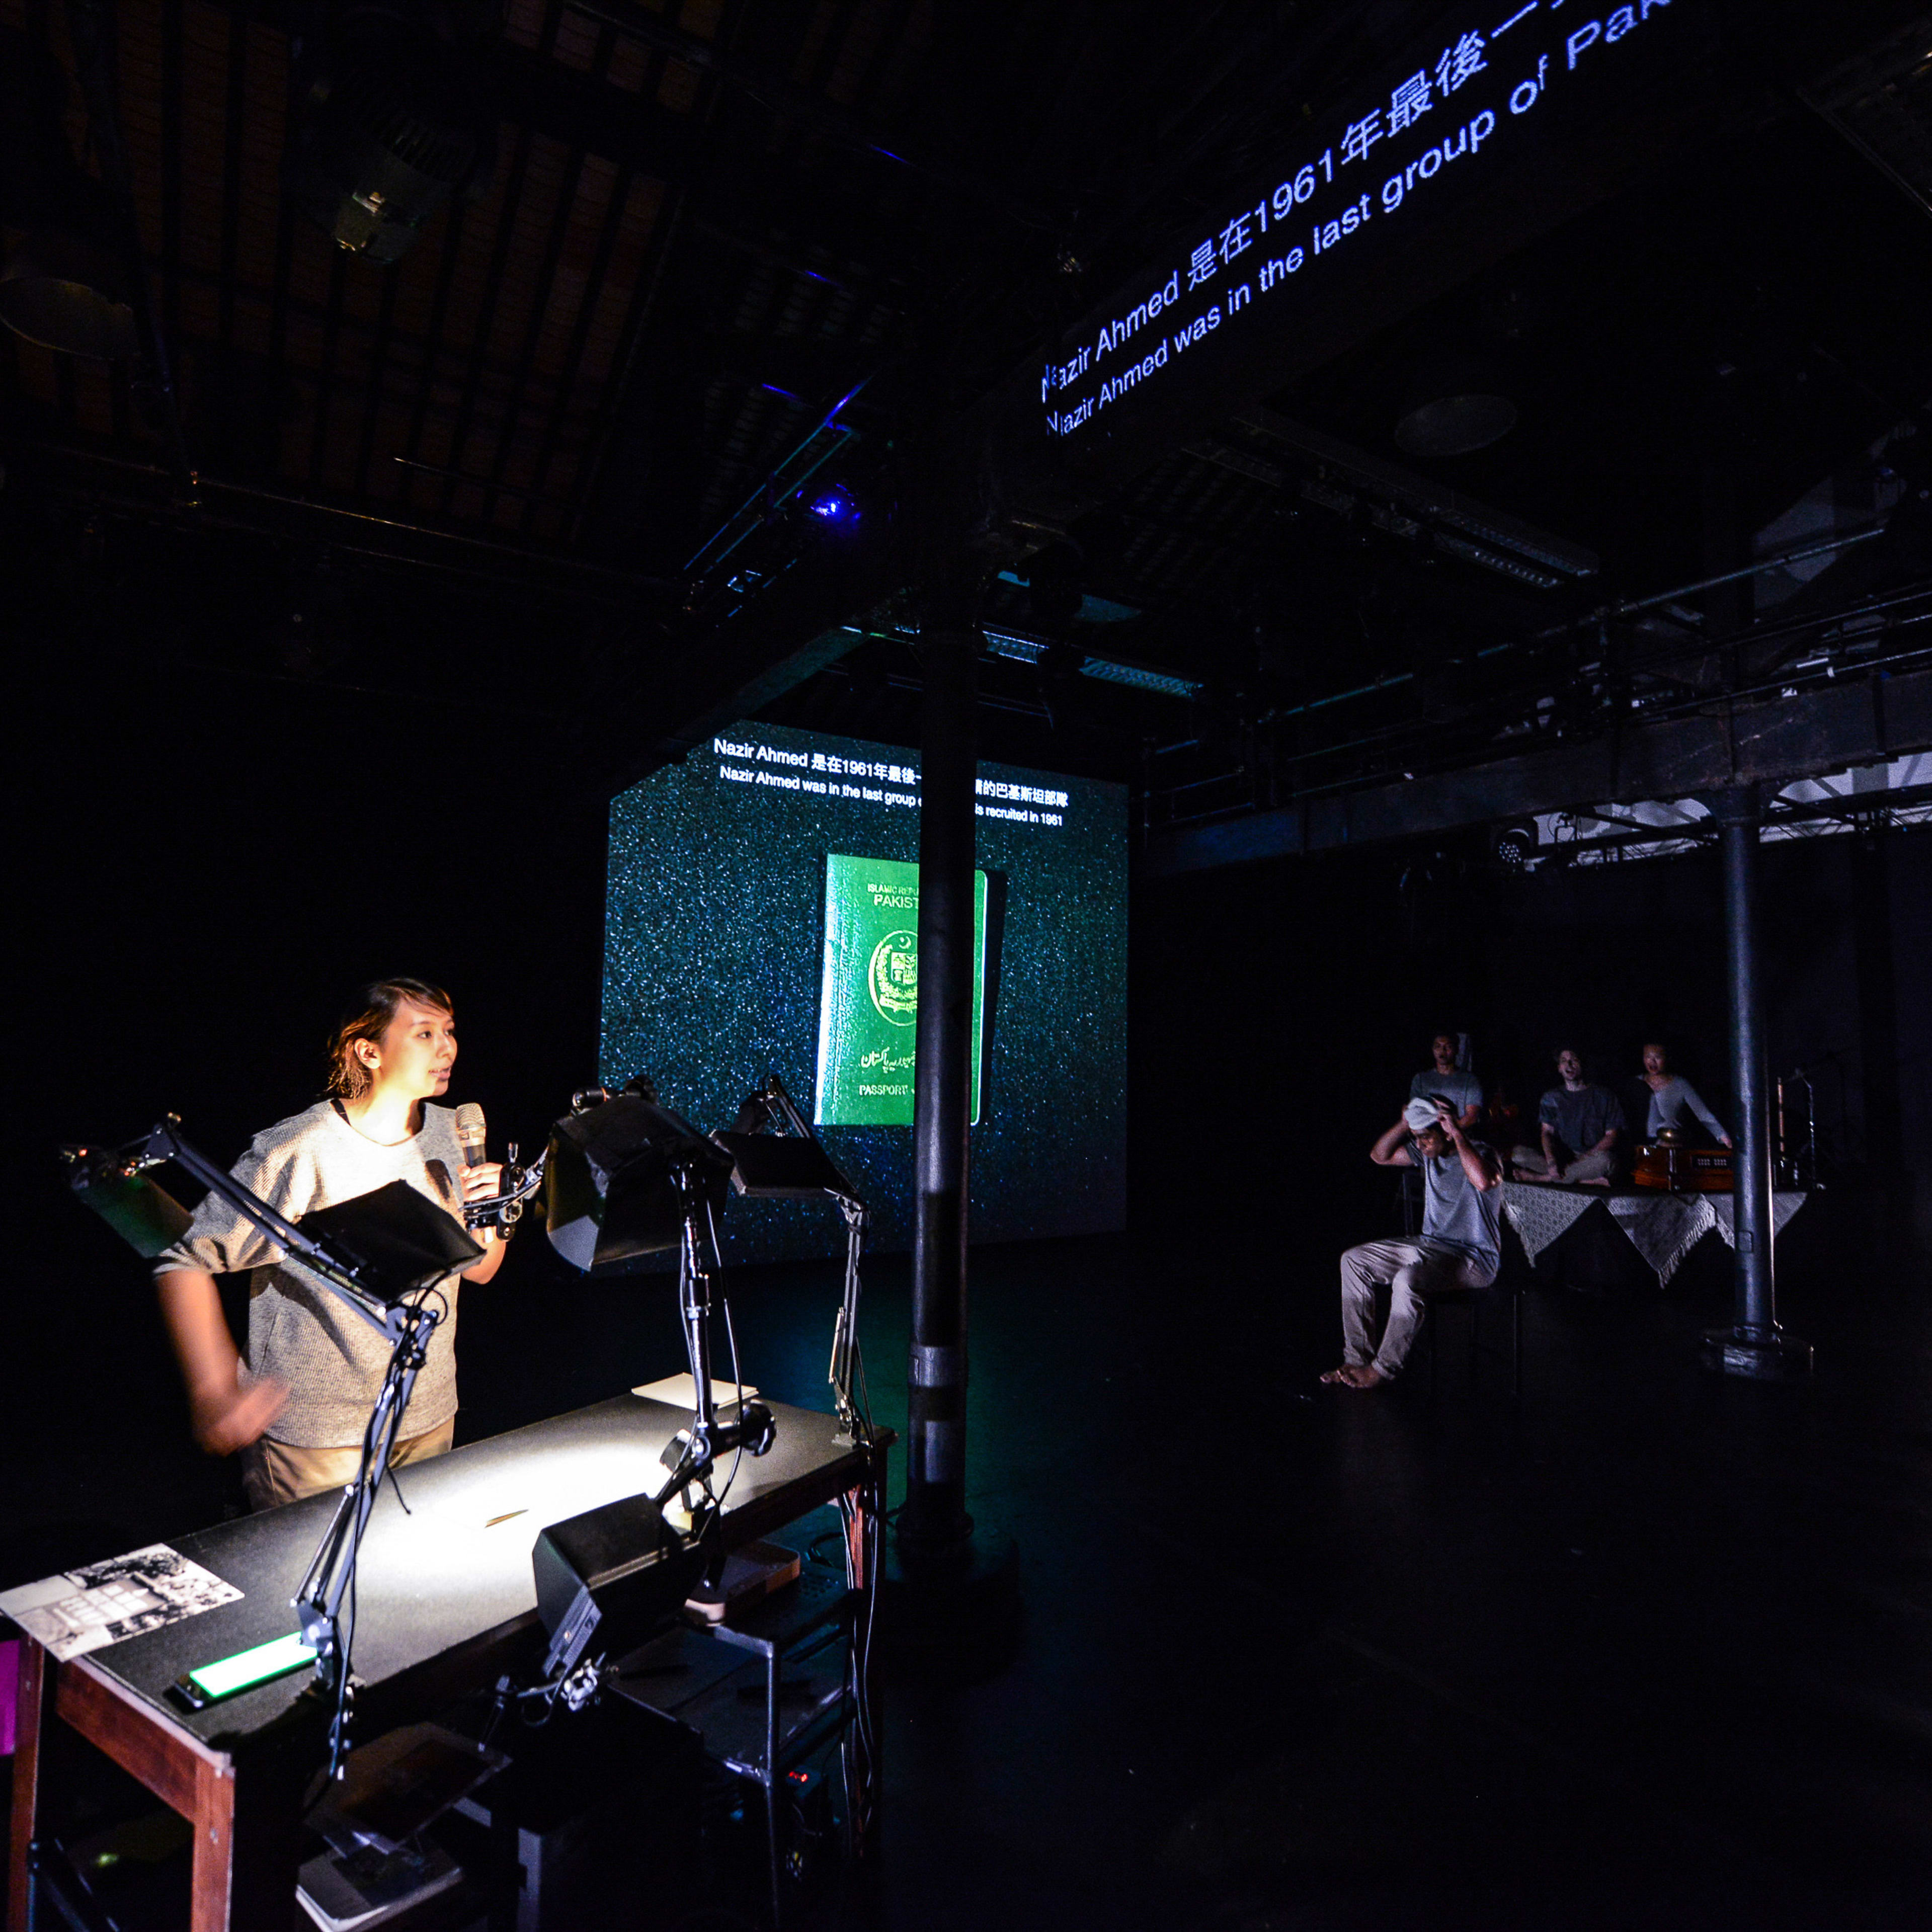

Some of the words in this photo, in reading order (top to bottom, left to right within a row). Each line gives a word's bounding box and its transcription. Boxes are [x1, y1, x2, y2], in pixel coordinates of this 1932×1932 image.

[1095, 270, 1179, 361] Ahmed
[1187, 0, 1565, 292] 是在1961年最後一
[1098, 338, 1168, 410] Ahmed
[1174, 305, 1220, 352] was
[1228, 283, 1251, 315] in
[1259, 246, 1304, 292] the
[1313, 194, 1372, 255] last
[1381, 109, 1495, 213] group
[1509, 53, 1548, 115] of
[713, 738, 754, 759] Nazir
[756, 745, 809, 767] Ahmed
[719, 765, 755, 783] Nazir
[756, 771, 800, 790] Ahmed
[802, 779, 827, 794] was
[829, 782, 841, 796] in
[842, 784, 861, 799] the
[862, 786, 883, 801] last
[884, 792, 917, 808] group
[985, 807, 1028, 822] recruited
[1029, 811, 1039, 823] in
[1040, 813, 1063, 826] 1961
[873, 894, 919, 910] PAKIST
[859, 1084, 908, 1096] PASSPORT
